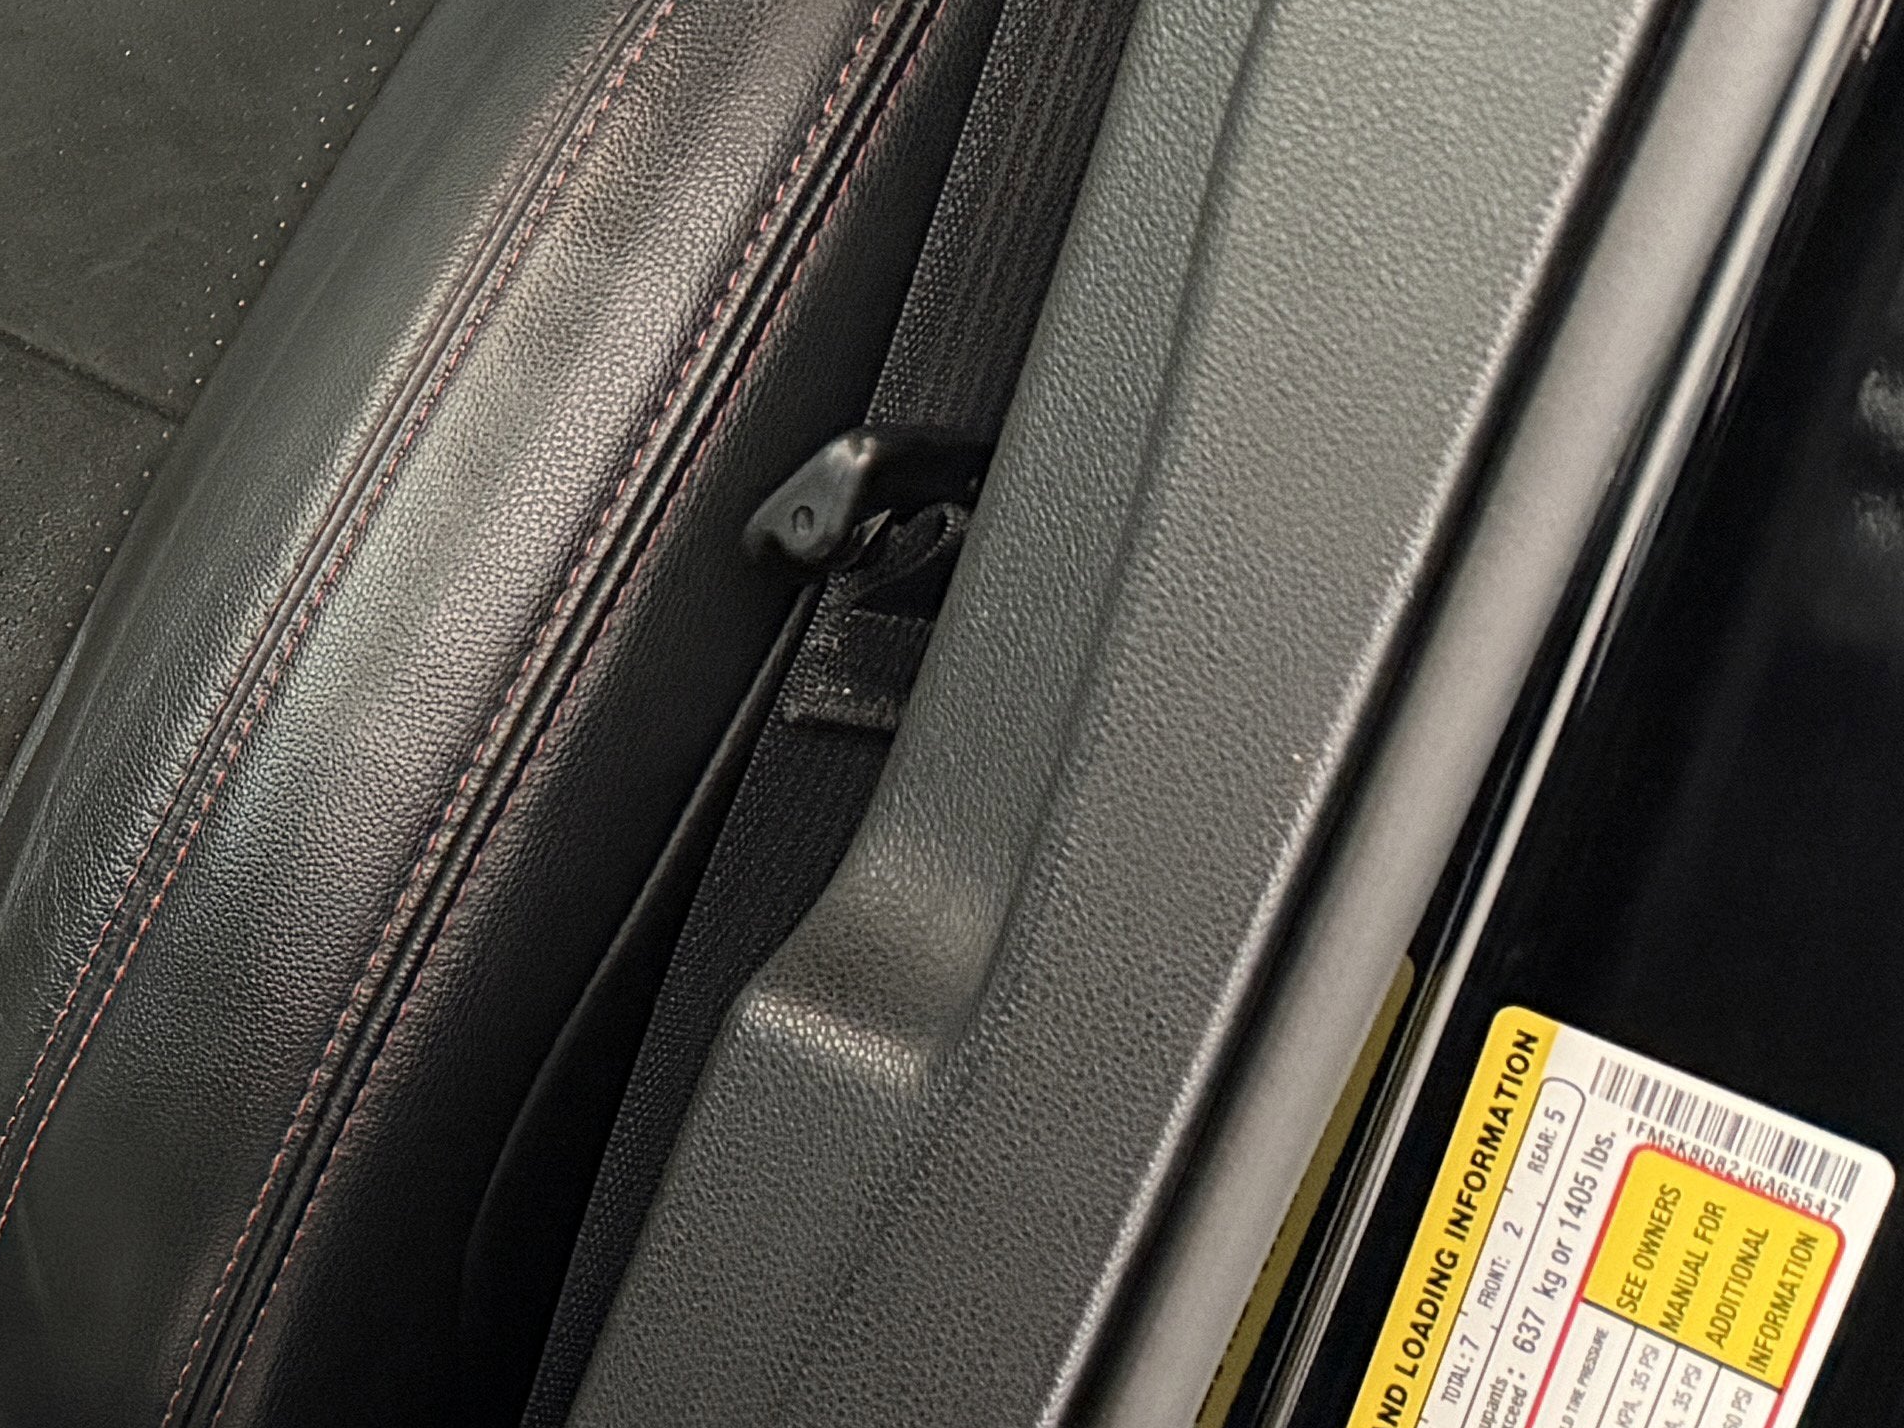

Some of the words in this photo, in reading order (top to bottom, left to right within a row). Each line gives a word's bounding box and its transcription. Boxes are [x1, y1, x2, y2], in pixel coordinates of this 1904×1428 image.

[1541, 1104, 1567, 1125] 5
[1525, 1125, 1558, 1175] REAR:
[1578, 1129, 1618, 1173] lbs.
[1392, 1246, 1461, 1380] LOADING
[1442, 1027, 1540, 1243] INFORMATION
[1556, 1169, 1599, 1232] 1405
[1630, 1181, 1683, 1272] OWNERS
[1475, 1254, 1512, 1311] FRONT:
[1500, 1219, 1525, 1240] 2
[1549, 1235, 1574, 1266] or
[1656, 1248, 1710, 1335] MANUAL
[1691, 1199, 1728, 1246] FOR
[1530, 1267, 1568, 1301] kg
[1614, 1269, 1649, 1315] SEE
[1703, 1225, 1770, 1351] ADDITIONAL
[1743, 1229, 1820, 1375] INFORMATION
[1457, 1332, 1480, 1352] 7
[1510, 1304, 1546, 1355] 637
[1575, 1325, 1610, 1388] PRESSURE
[1636, 1341, 1661, 1371] PSI
[1678, 1361, 1703, 1391] PSI
[1564, 1386, 1587, 1414] TIRE
[1628, 1366, 1652, 1393] 35
[1669, 1387, 1694, 1413] 35
[1728, 1384, 1754, 1415] PSI
